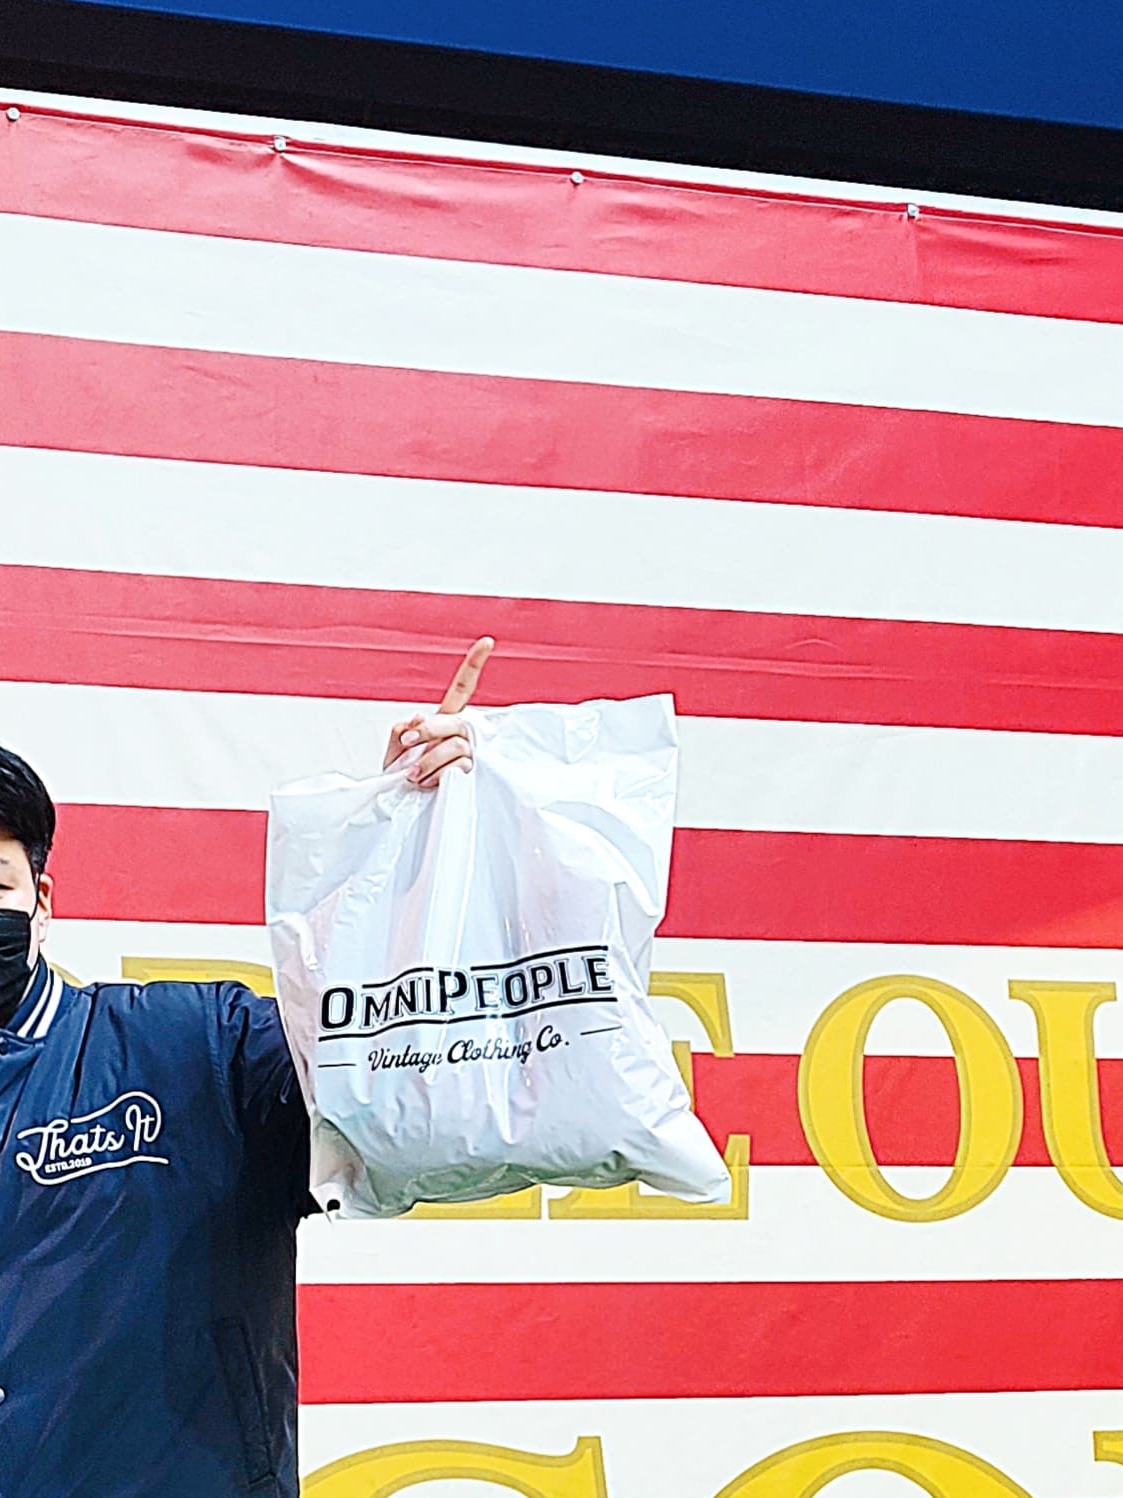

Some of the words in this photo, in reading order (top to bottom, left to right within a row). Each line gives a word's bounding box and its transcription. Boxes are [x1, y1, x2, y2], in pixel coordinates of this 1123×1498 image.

[318, 953, 615, 1031] OMNIPEOPLE
[367, 1045, 443, 1073] Vintage
[447, 1038, 532, 1065] Clothing
[535, 1025, 570, 1051] Co.
[16, 1118, 125, 1171] Thats
[125, 1103, 158, 1152] It
